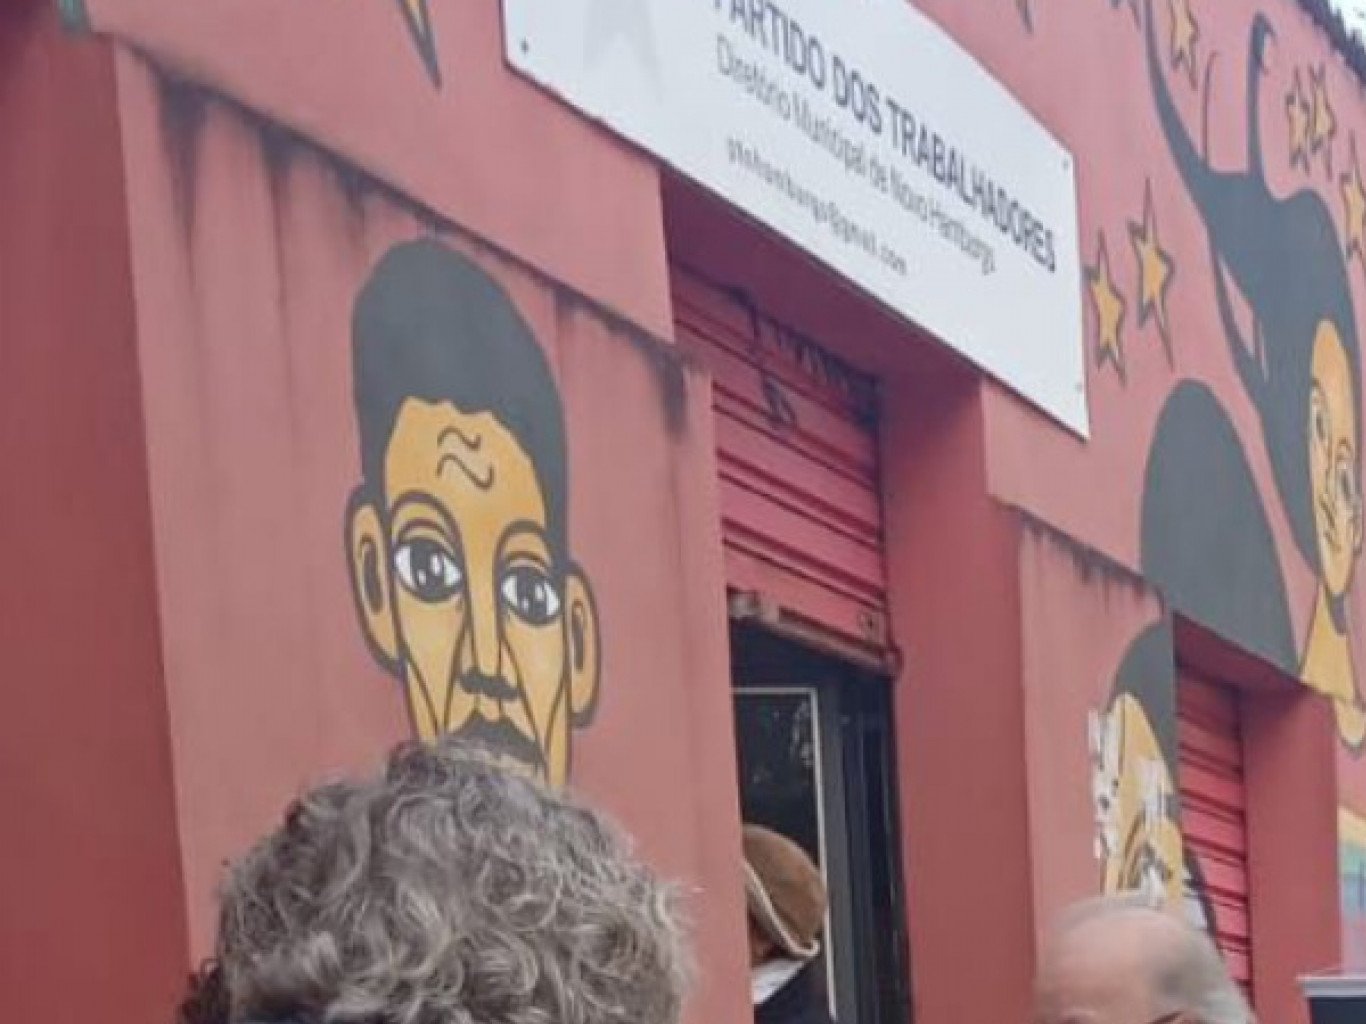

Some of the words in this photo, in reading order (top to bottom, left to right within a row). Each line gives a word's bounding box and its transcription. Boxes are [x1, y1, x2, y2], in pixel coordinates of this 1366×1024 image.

[714, 0, 825, 90] ARTIDO
[832, 53, 882, 135] DOS
[886, 94, 1056, 274] TRABALHADORES
[870, 154, 888, 194] de
